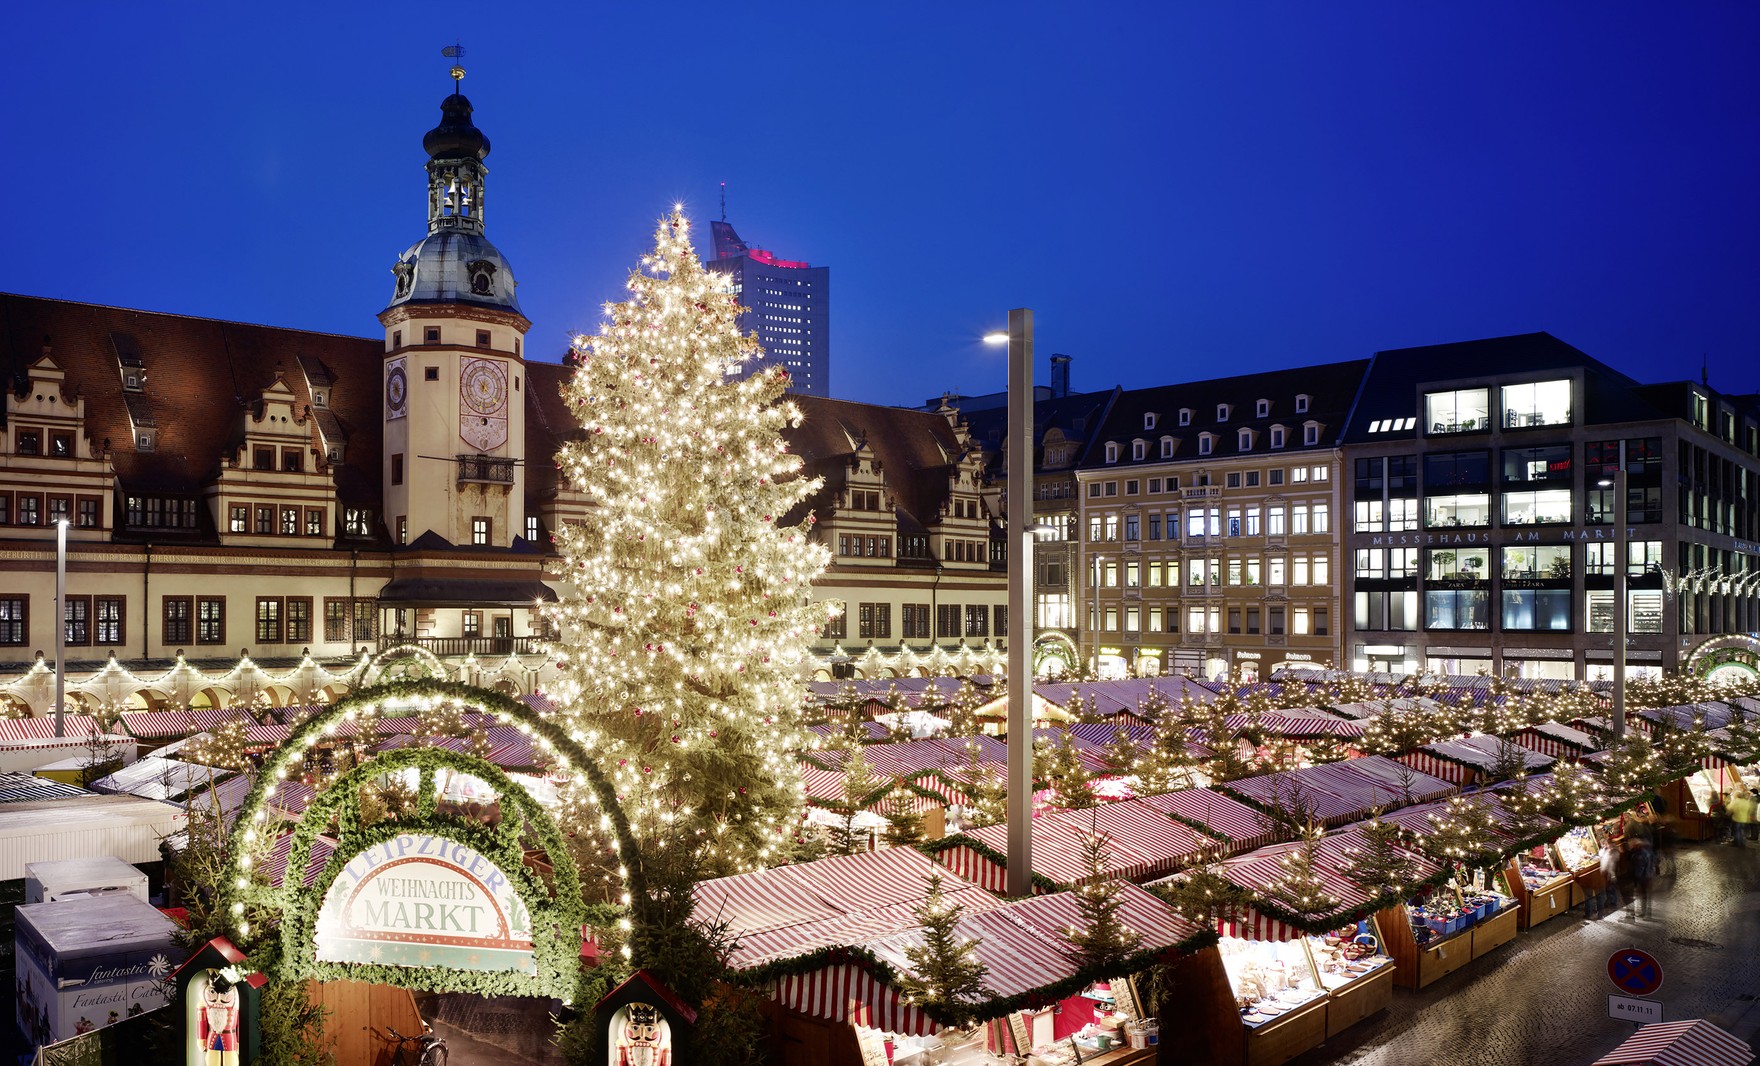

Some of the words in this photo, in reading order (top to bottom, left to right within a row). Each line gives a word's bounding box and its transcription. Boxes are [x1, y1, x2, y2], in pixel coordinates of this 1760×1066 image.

[1373, 533, 1489, 545] MESSEHAUS
[1515, 532, 1539, 541] AM
[345, 836, 504, 895] LEIPZIGER
[376, 878, 475, 900] WEIHNACHTS
[365, 899, 485, 933] MARKT
[80, 962, 147, 986] fantastic
[73, 990, 127, 1009] Fantastic
